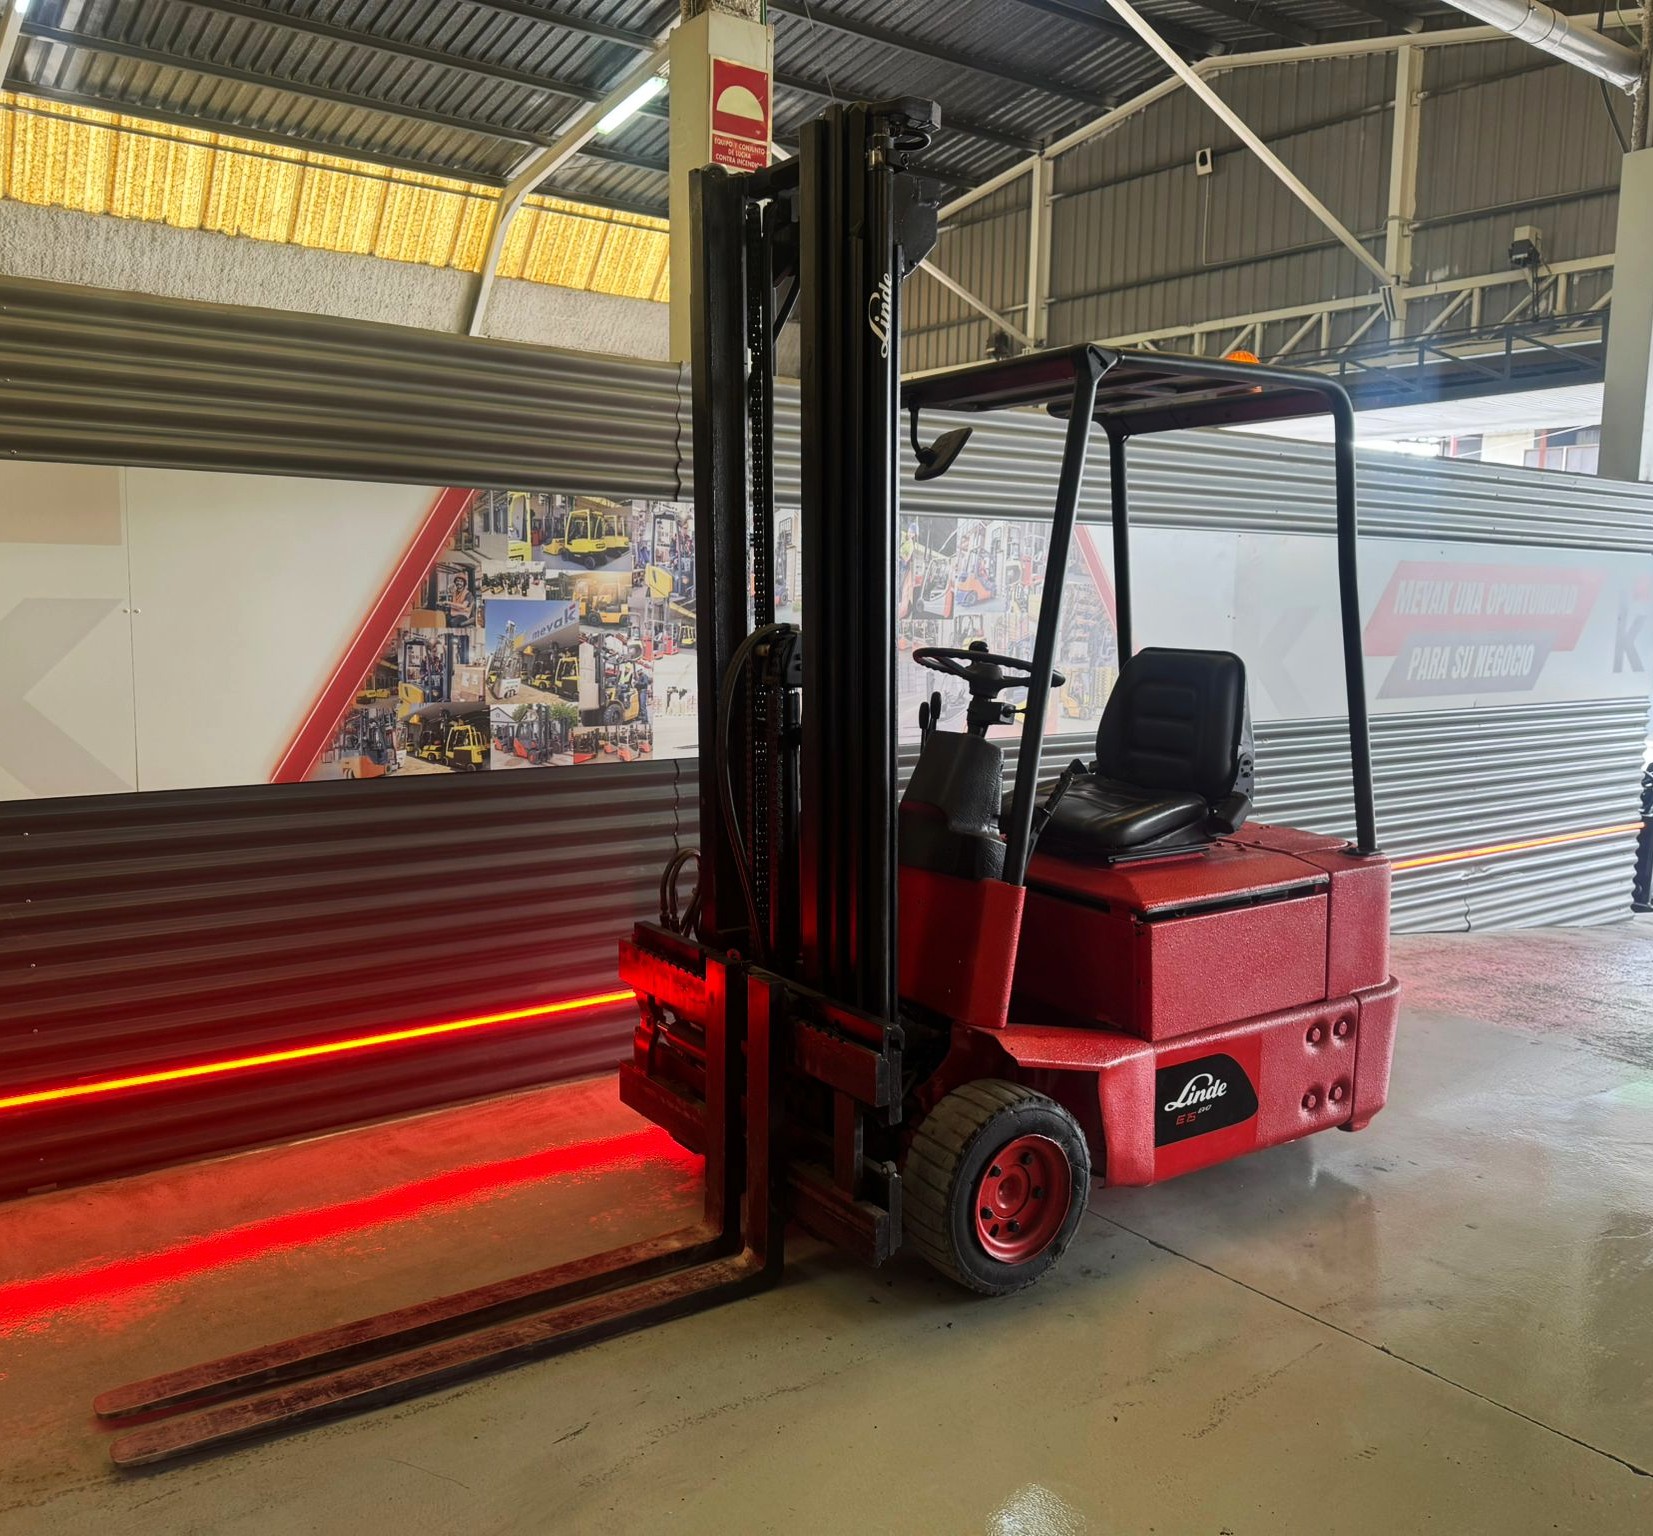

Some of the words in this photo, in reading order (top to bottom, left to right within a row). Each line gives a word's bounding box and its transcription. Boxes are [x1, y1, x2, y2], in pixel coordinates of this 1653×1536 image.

[714, 137, 733, 147] EQUIPO
[739, 143, 765, 155] CONJUNTO
[715, 153, 736, 164] CONTRA
[868, 272, 892, 359] Linde
[1393, 579, 1454, 616] MEVAK
[1453, 580, 1485, 616] UNA
[531, 607, 576, 640] mevak
[1406, 646, 1452, 681] PARA
[1451, 644, 1475, 680] SU
[1473, 643, 1536, 679] NEGOCIO
[1164, 1073, 1227, 1112] Linde
